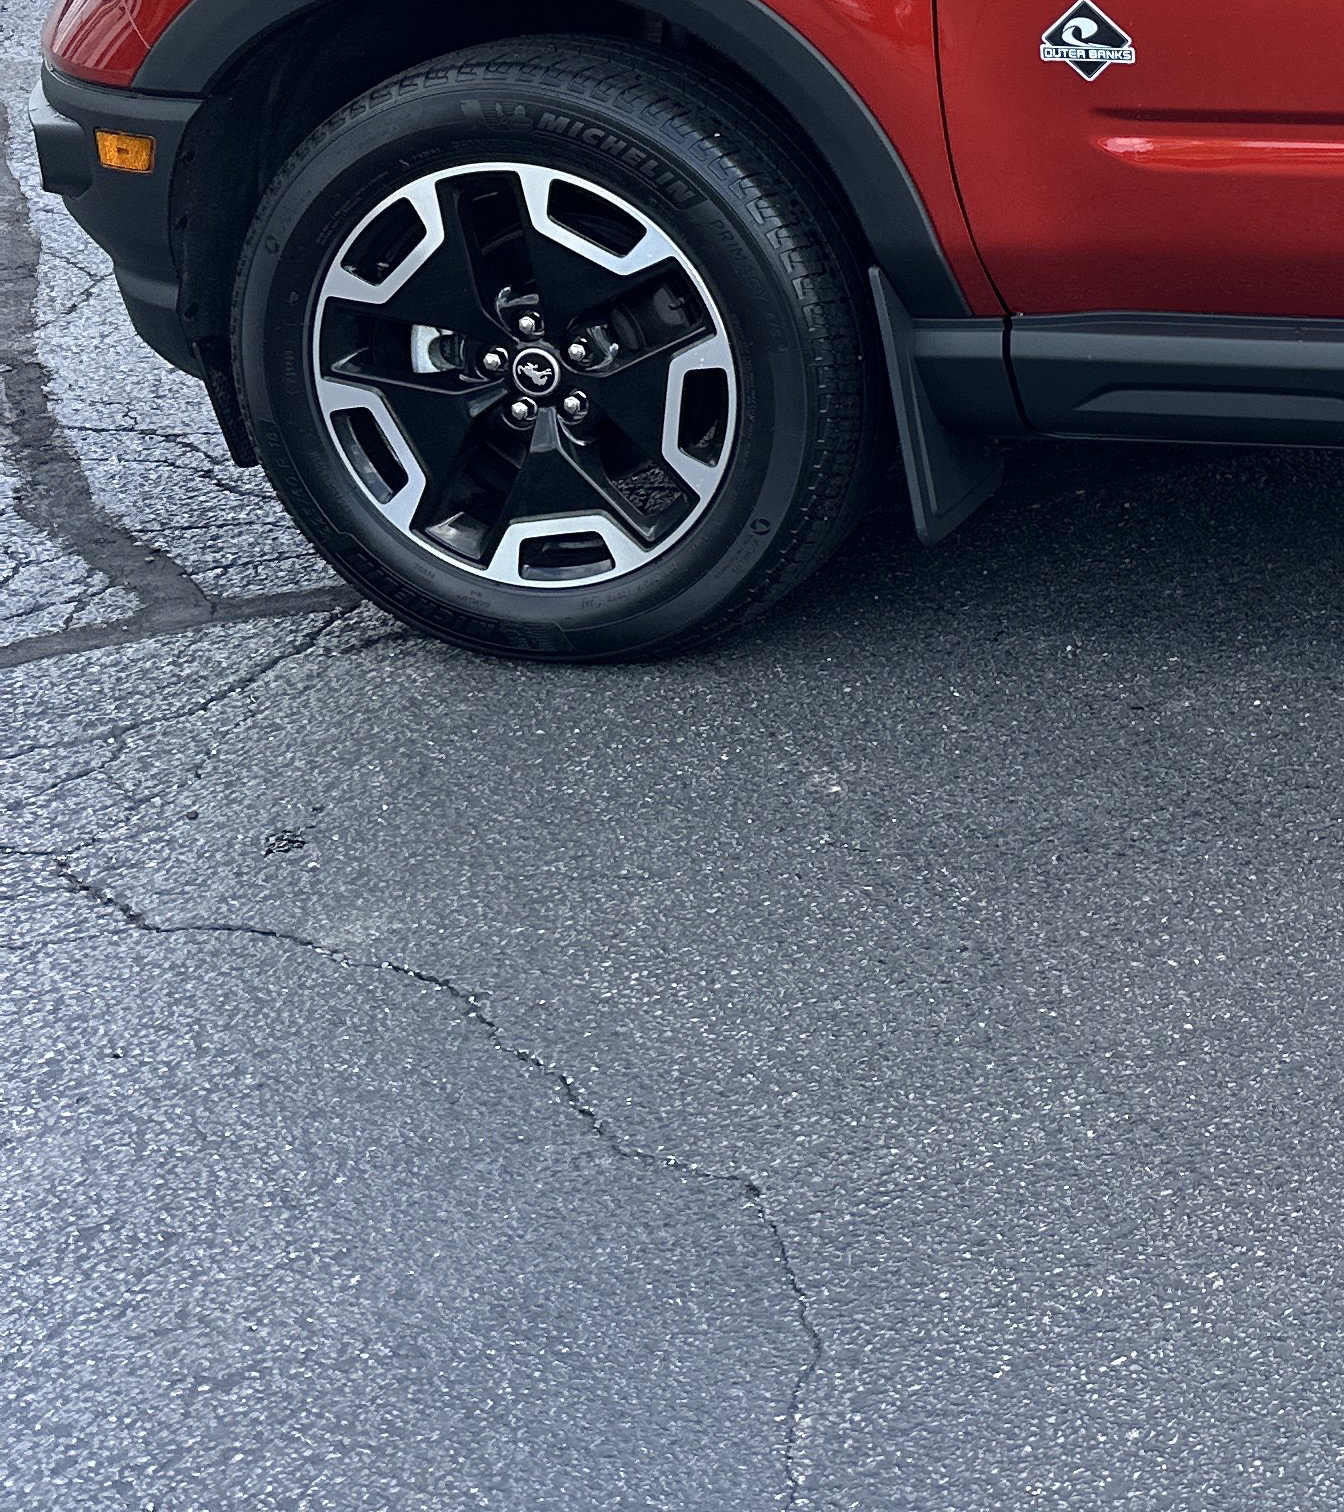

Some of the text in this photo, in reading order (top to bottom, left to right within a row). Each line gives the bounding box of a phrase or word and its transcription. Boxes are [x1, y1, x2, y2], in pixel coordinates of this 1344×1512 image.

[1044, 48, 1132, 60] OUTER BANKS
[537, 112, 696, 204] MICHELIN
